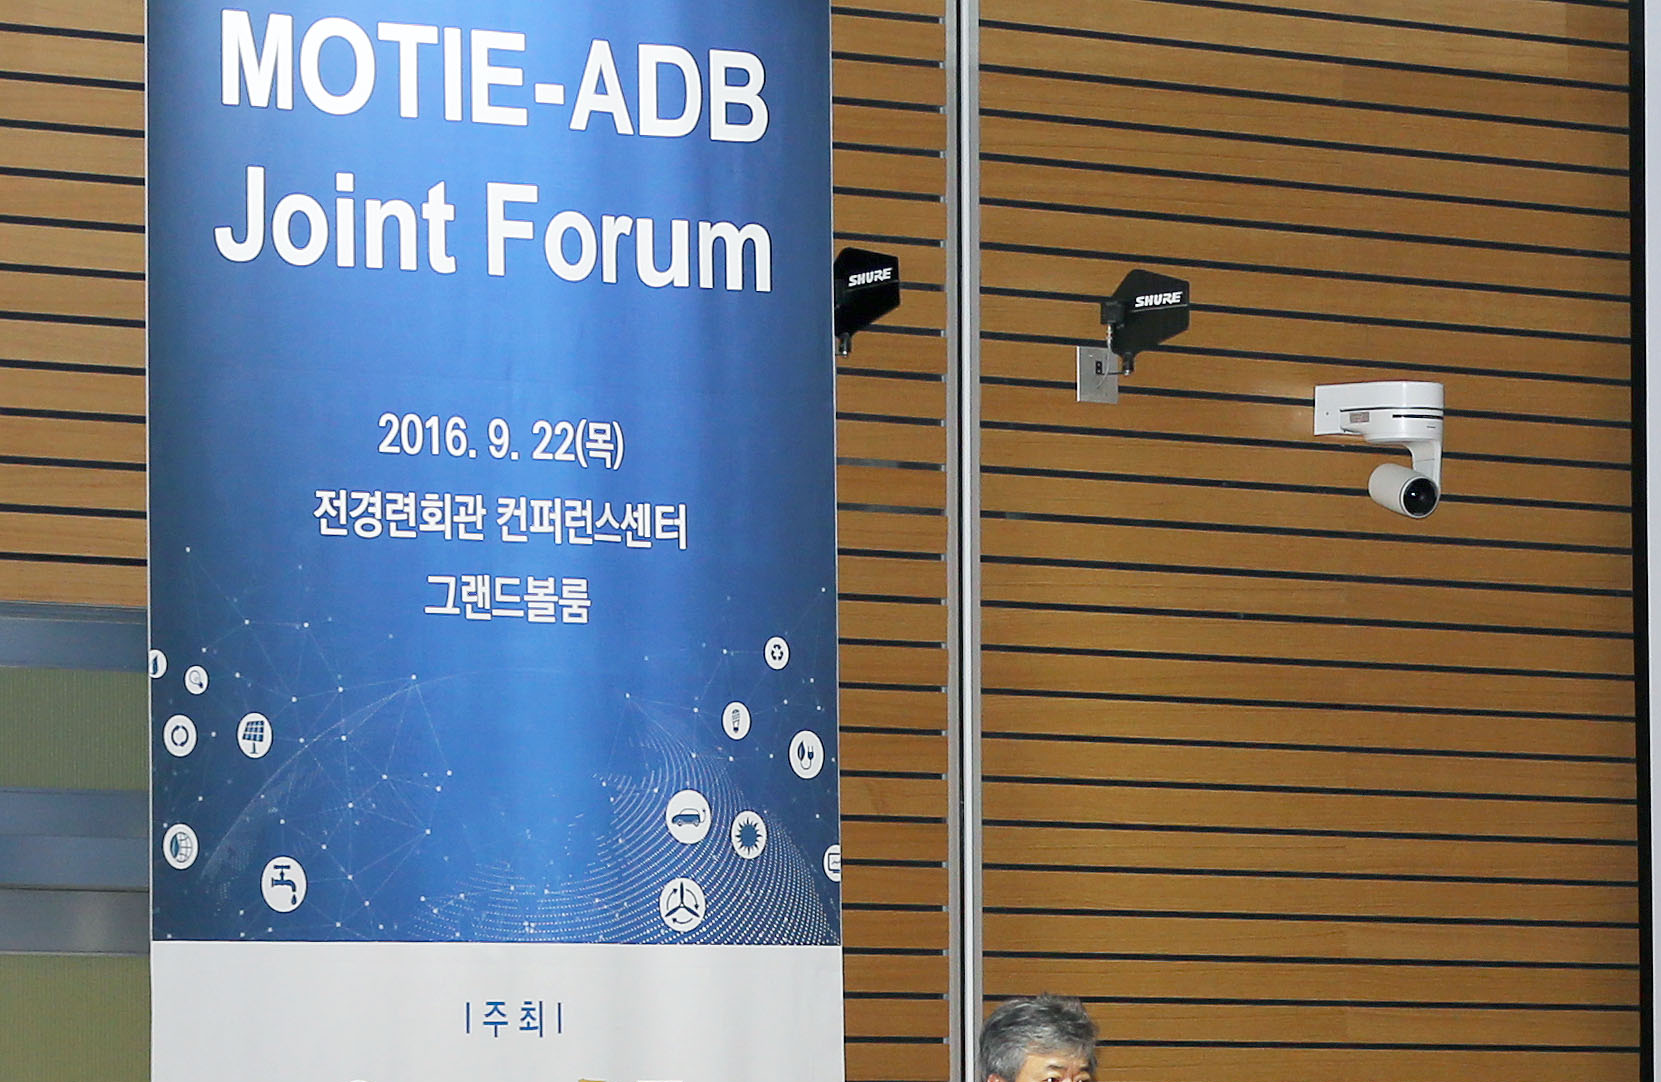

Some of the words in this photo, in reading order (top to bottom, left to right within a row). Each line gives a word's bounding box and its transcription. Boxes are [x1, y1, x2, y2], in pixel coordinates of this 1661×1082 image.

[223, 10, 767, 141] MOTIE-ADB
[215, 167, 455, 273] Joint
[487, 183, 770, 291] Forum
[849, 268, 892, 286] SHURE
[1135, 292, 1182, 307] SHURE
[379, 414, 476, 457] 2016.
[489, 419, 518, 459] 9.
[533, 419, 623, 469] 22(목)
[314, 490, 486, 540] 전경련회관
[497, 497, 686, 549] 컨퍼런스센터
[425, 575, 590, 623] 그랜드볼룸
